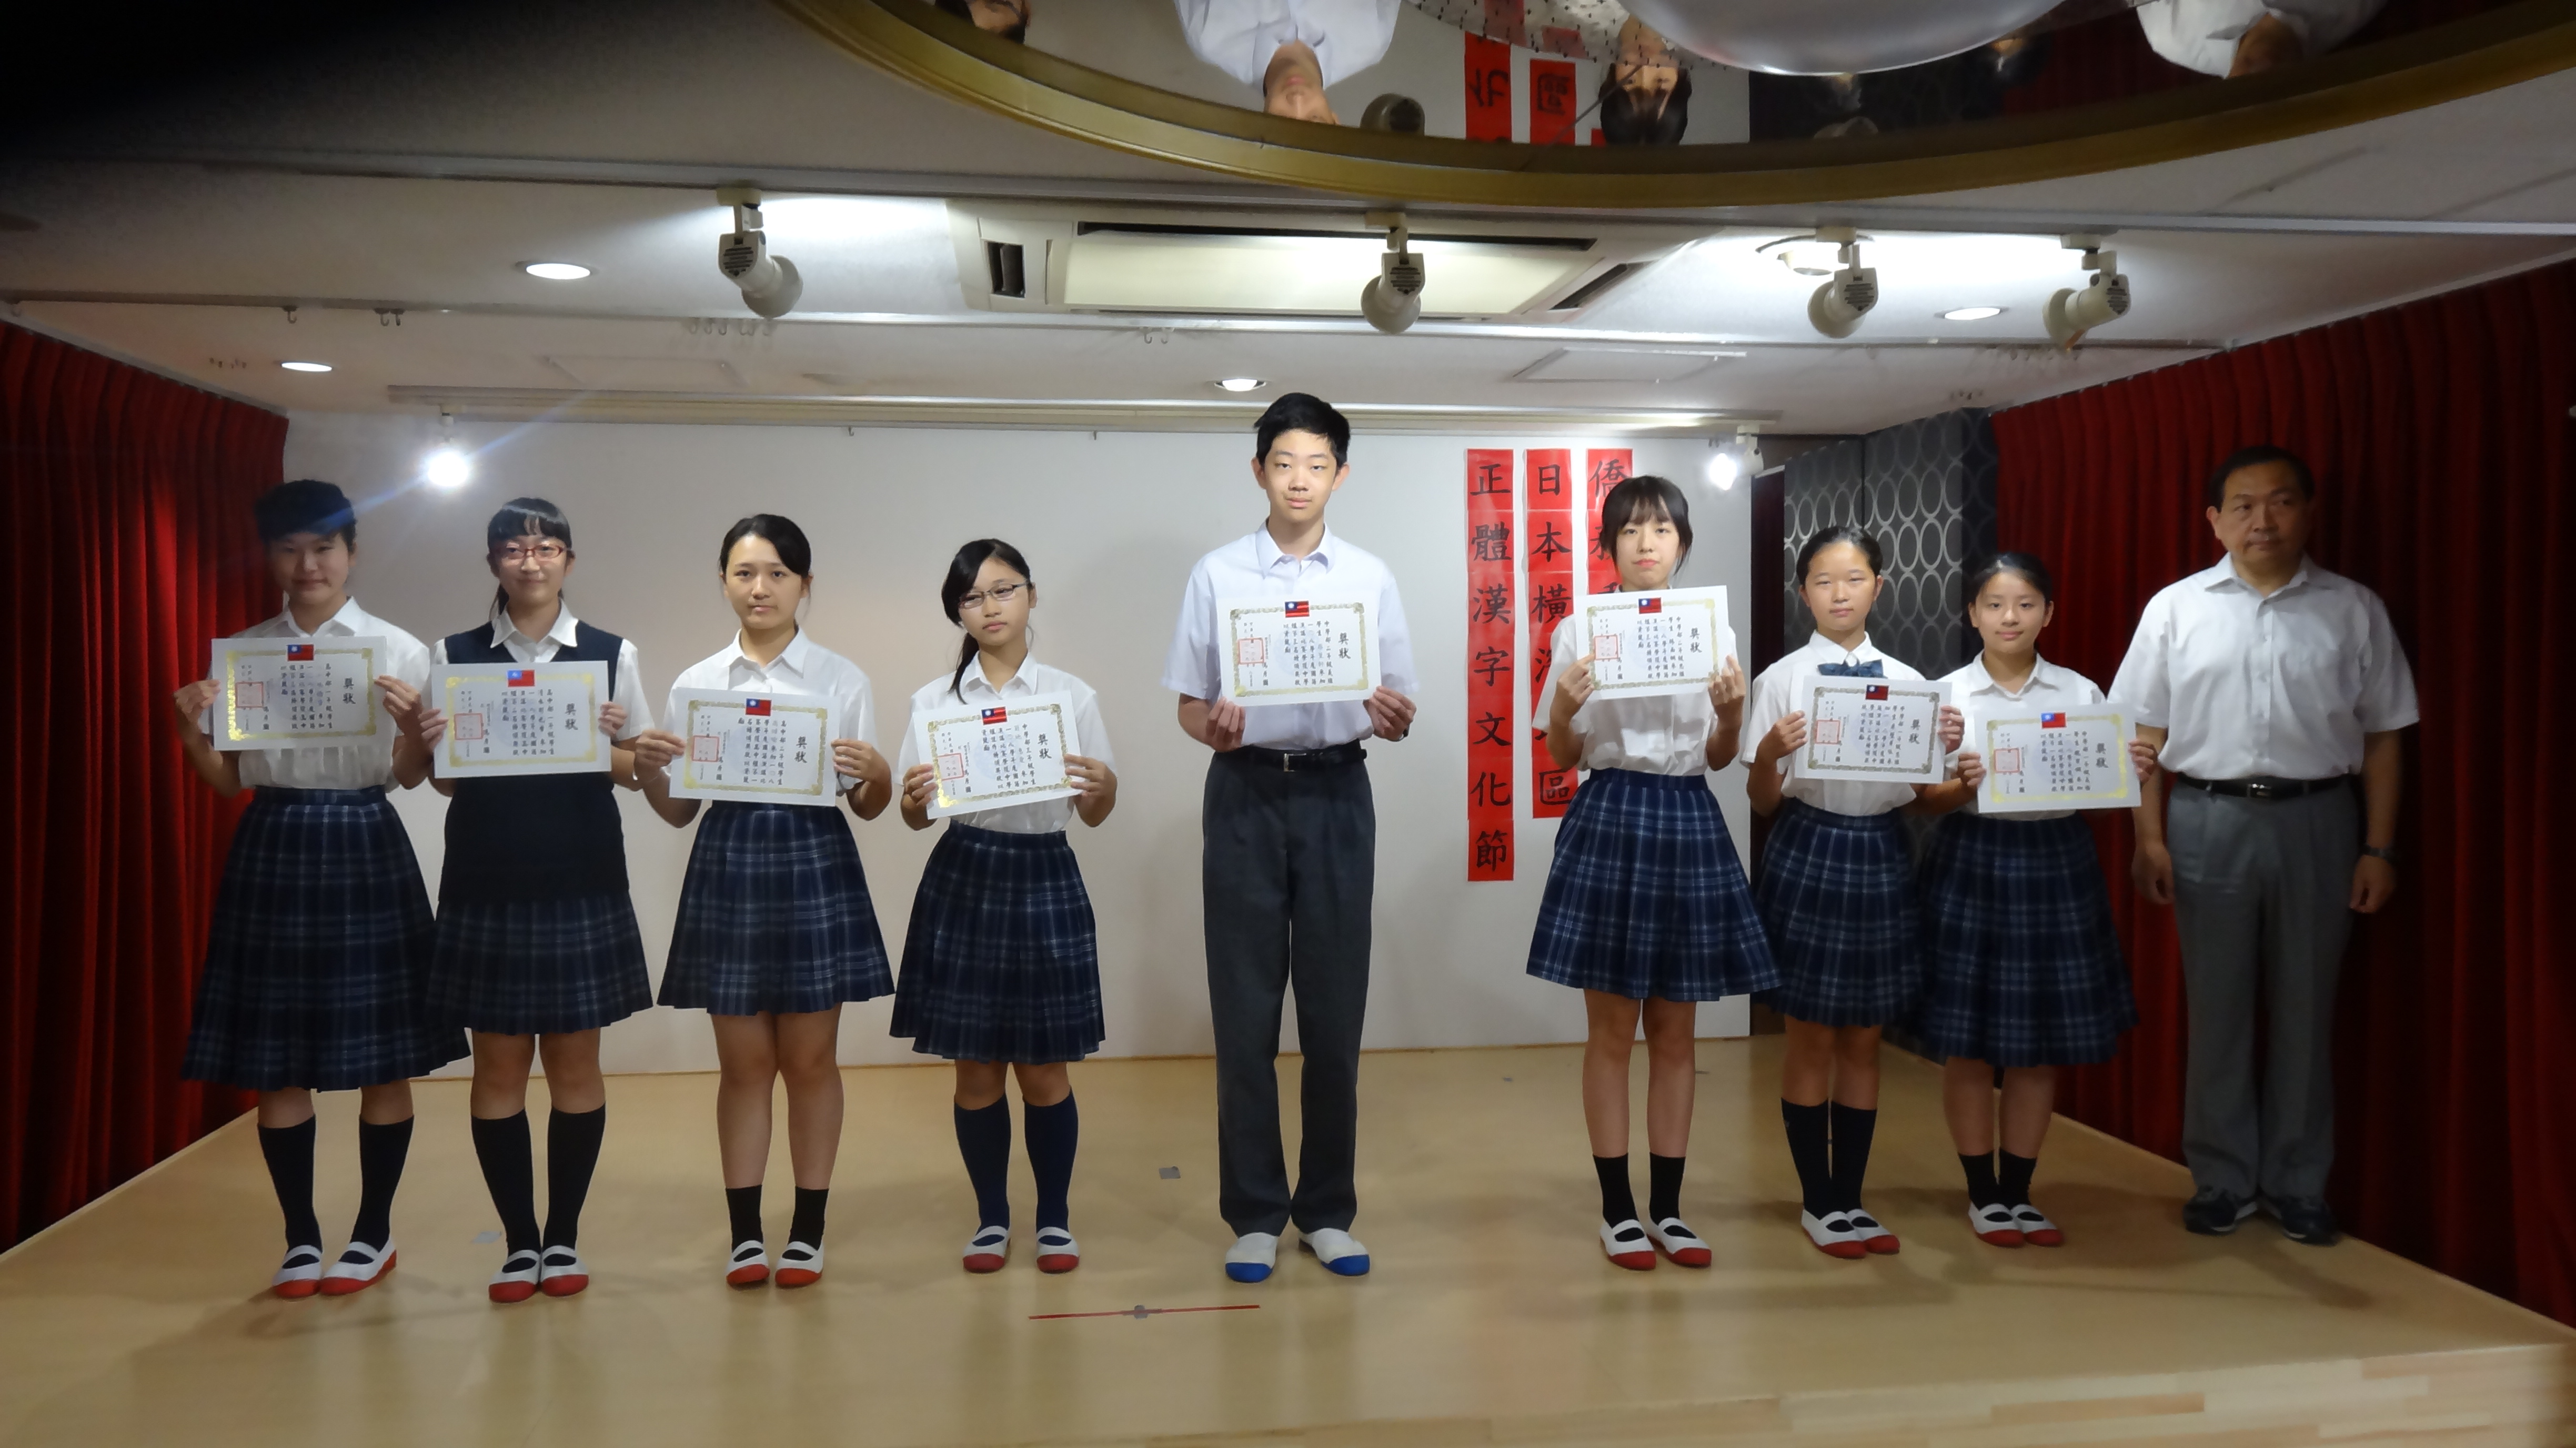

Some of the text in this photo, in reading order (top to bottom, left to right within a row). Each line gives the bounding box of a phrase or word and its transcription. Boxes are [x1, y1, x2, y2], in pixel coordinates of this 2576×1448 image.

[1470, 464, 1512, 871] 正體漢字文化節
[1531, 464, 1572, 805] 日本橫區
